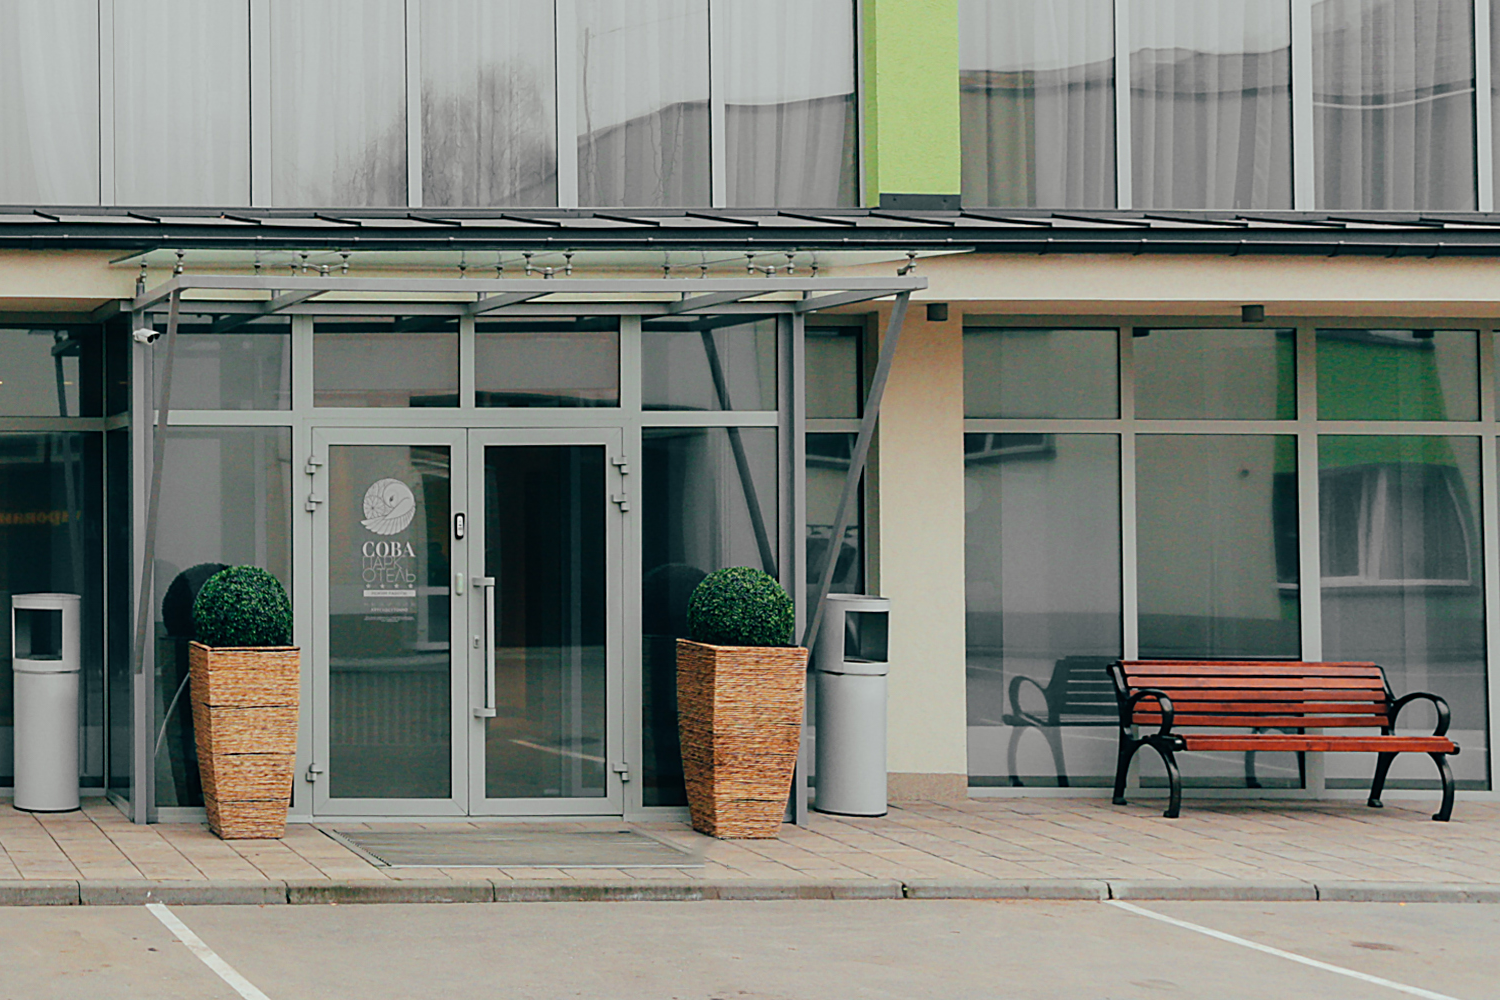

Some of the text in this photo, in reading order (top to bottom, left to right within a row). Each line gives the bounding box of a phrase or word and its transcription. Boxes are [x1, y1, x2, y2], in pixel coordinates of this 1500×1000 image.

[362, 541, 416, 557] СОВА
[362, 556, 402, 569] ПАРК
[362, 568, 416, 582] ОТЕЛЬ
